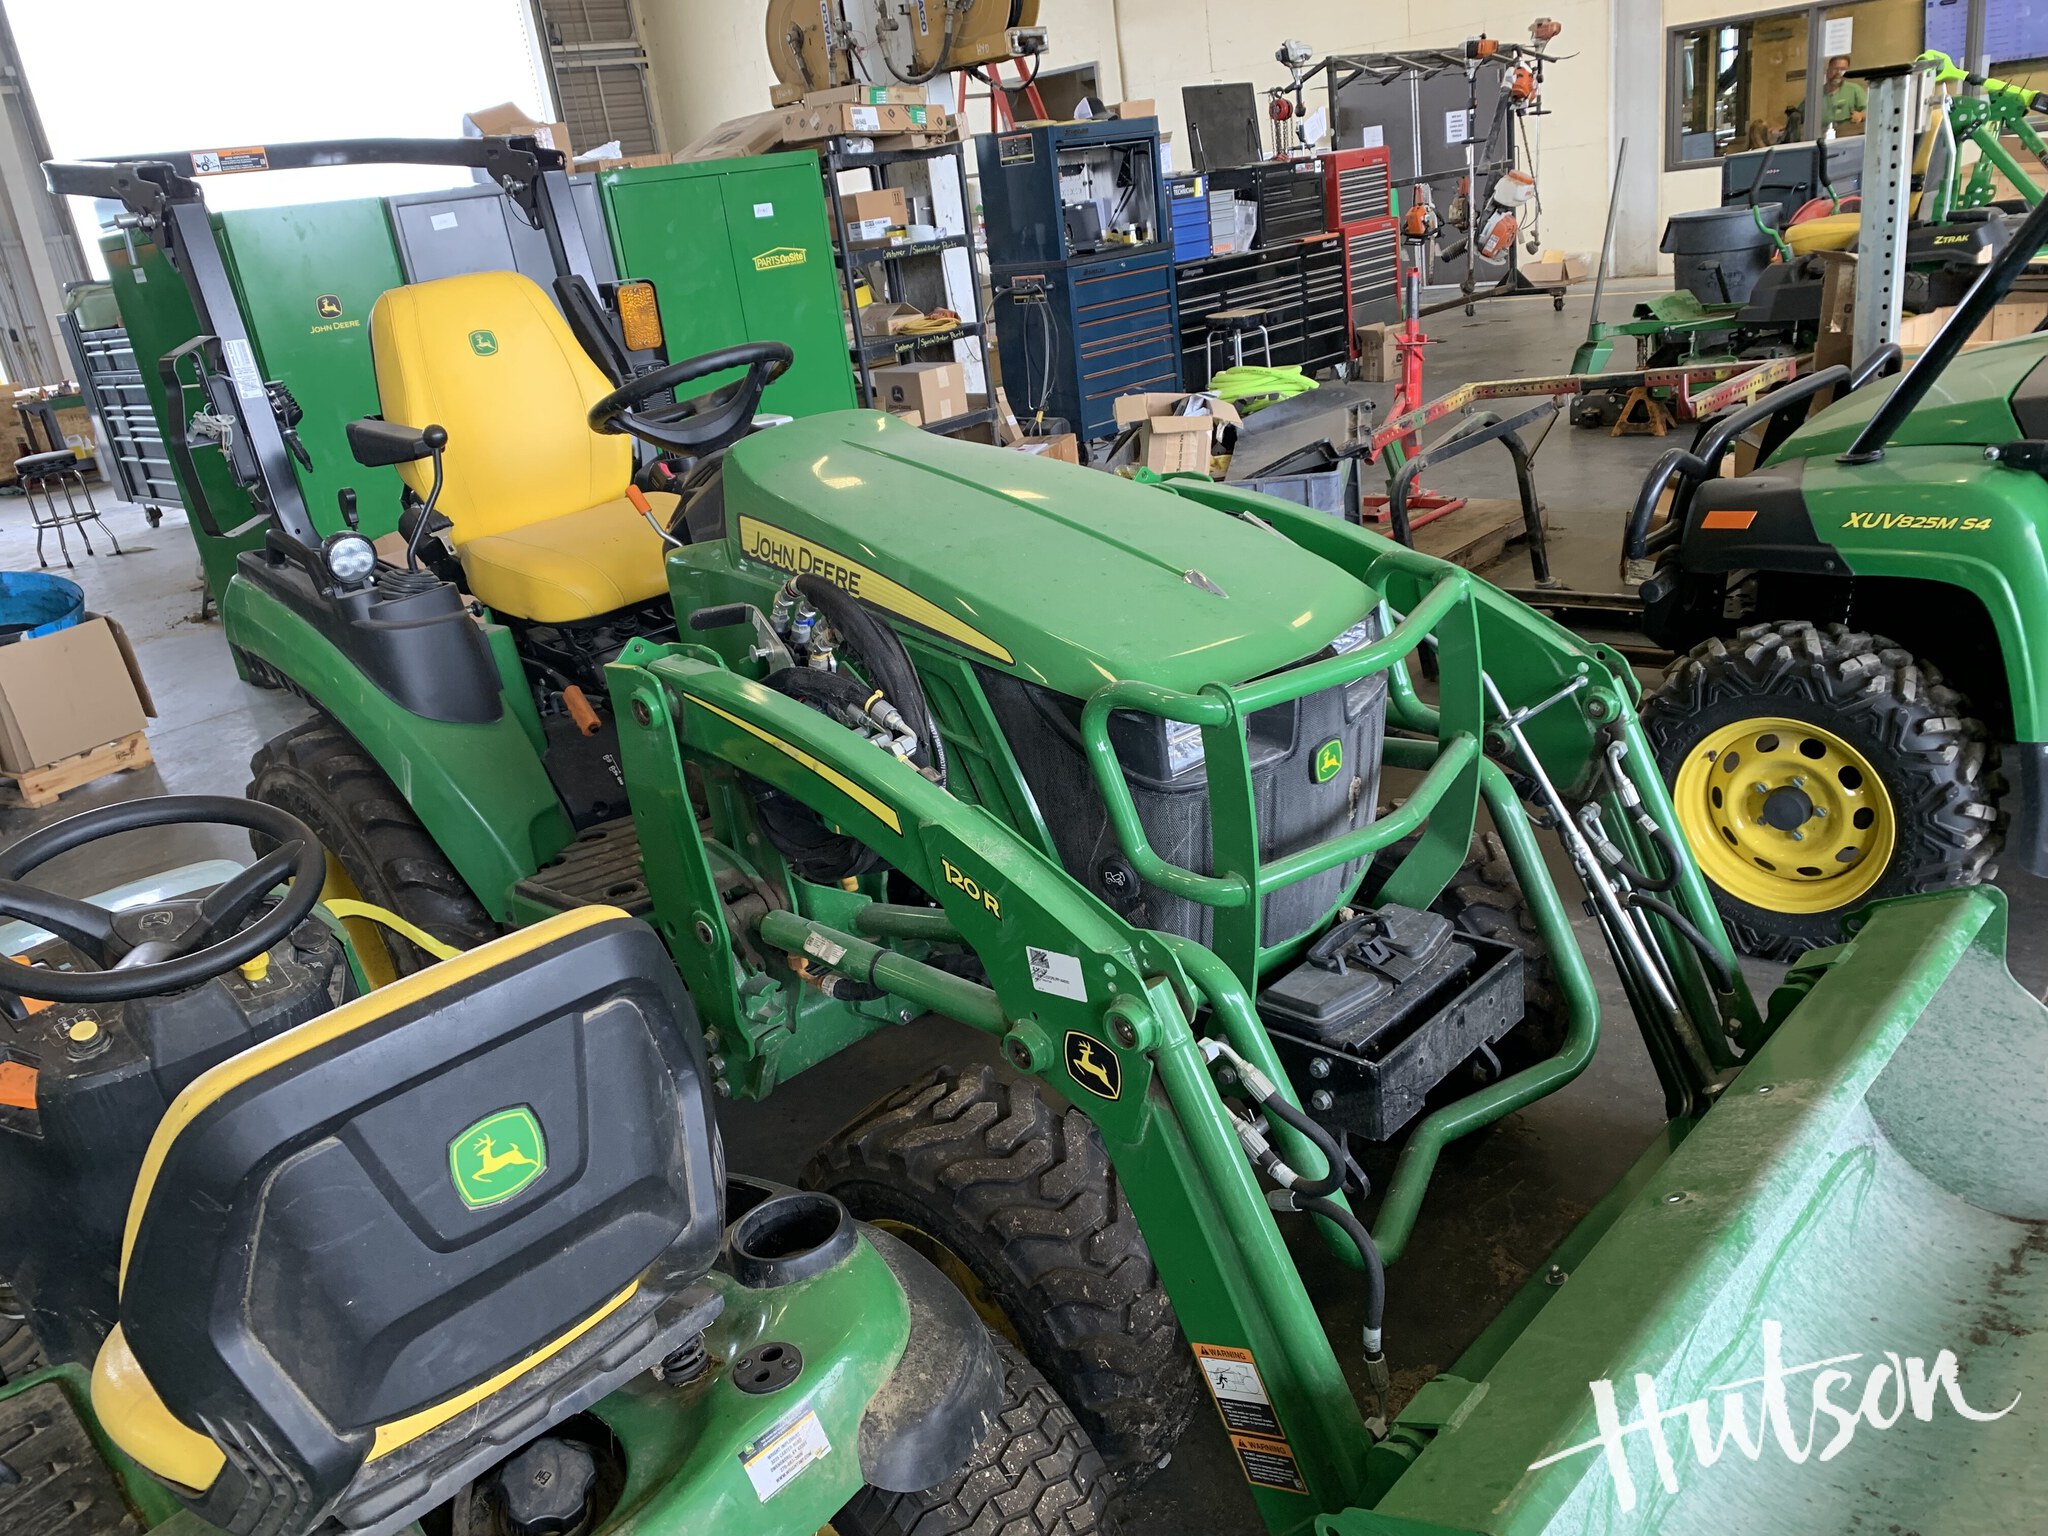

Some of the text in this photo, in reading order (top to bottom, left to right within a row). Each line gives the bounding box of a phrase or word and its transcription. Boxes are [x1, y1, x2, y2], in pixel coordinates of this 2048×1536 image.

[918, 0, 927, 32] ACO
[1933, 234, 1970, 245] ZTRAK
[882, 249, 905, 259] Customer
[942, 240, 957, 249] Parts
[310, 320, 360, 334] JOHN DEERE
[894, 342, 915, 353] Customer
[949, 329, 964, 339] Parts
[1841, 512, 1993, 530] XUV825M S4
[750, 531, 861, 596] JOHN DEERE
[941, 858, 1001, 919] 120 R
[1208, 1348, 1247, 1360] WARNING
[1249, 1441, 1286, 1454] WARNING
